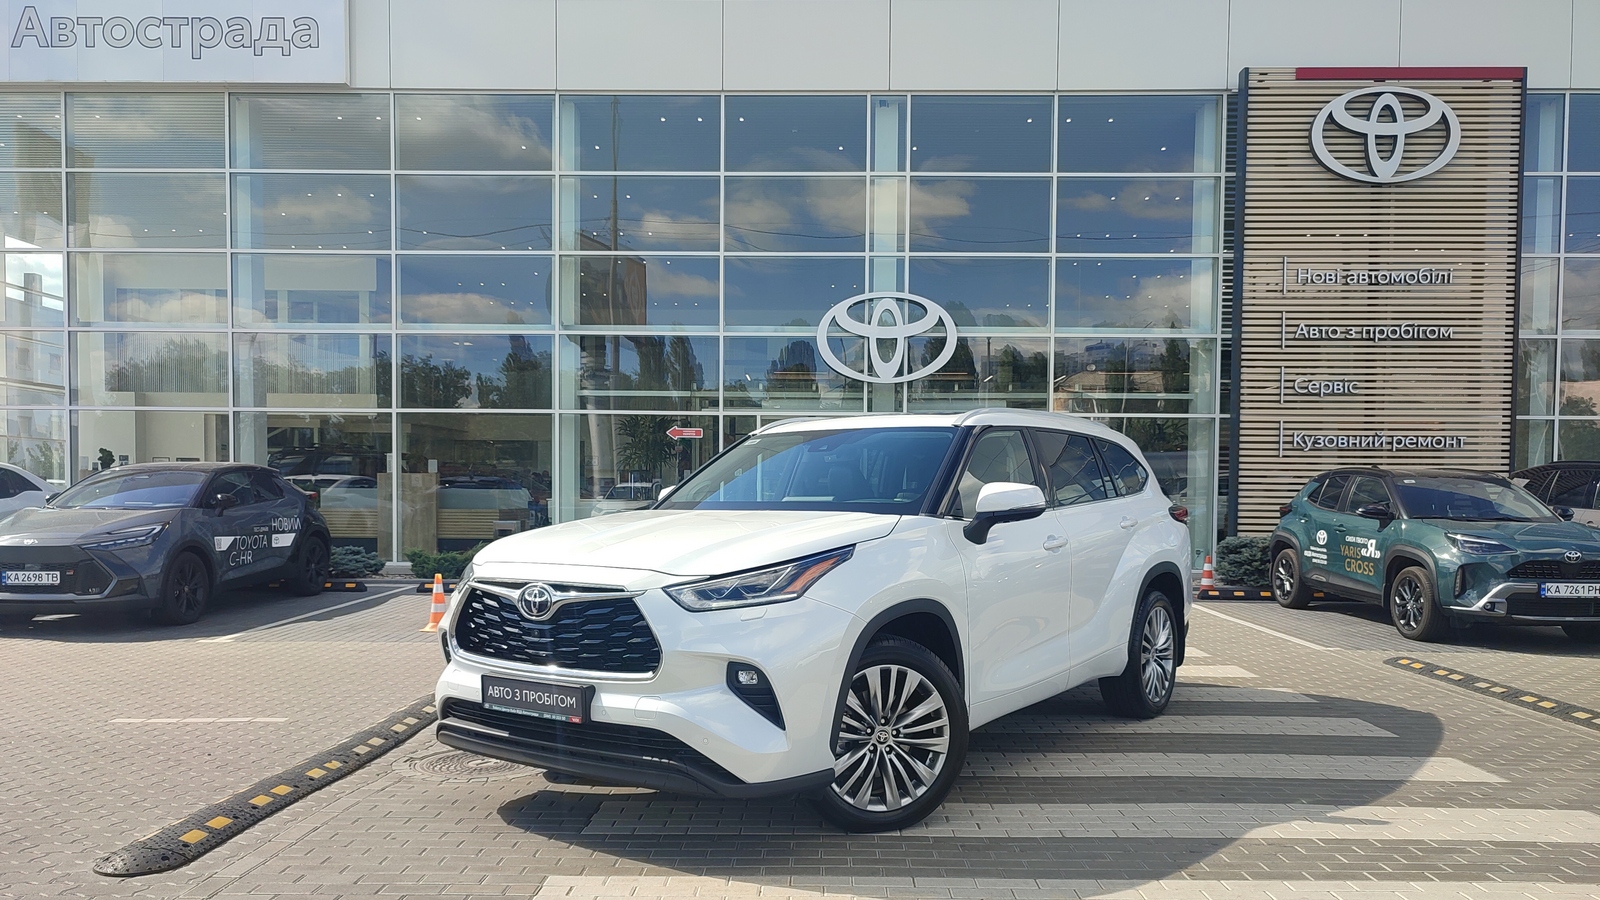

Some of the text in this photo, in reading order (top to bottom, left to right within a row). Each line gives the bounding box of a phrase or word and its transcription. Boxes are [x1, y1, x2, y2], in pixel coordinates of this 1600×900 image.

[10, 5, 320, 60] Автострада
[1296, 267, 1454, 285] Нові автомобілі
[1294, 322, 1454, 343] Авто з пробігом
[1293, 377, 1360, 397] Сервіс
[1292, 431, 1467, 452] Кузовний ремонт
[271, 515, 302, 531] НОВИЙ
[235, 534, 268, 550] TOYOTA
[229, 550, 253, 566] C-HR
[1340, 544, 1361, 559] YARIS
[1344, 558, 1374, 576] CROSS
[6, 573, 58, 582] KA 2698 TB
[1546, 585, 1561, 594] KA
[1564, 585, 1585, 594] 7261
[487, 685, 577, 709] АВТО З ПРОБІГОМ
